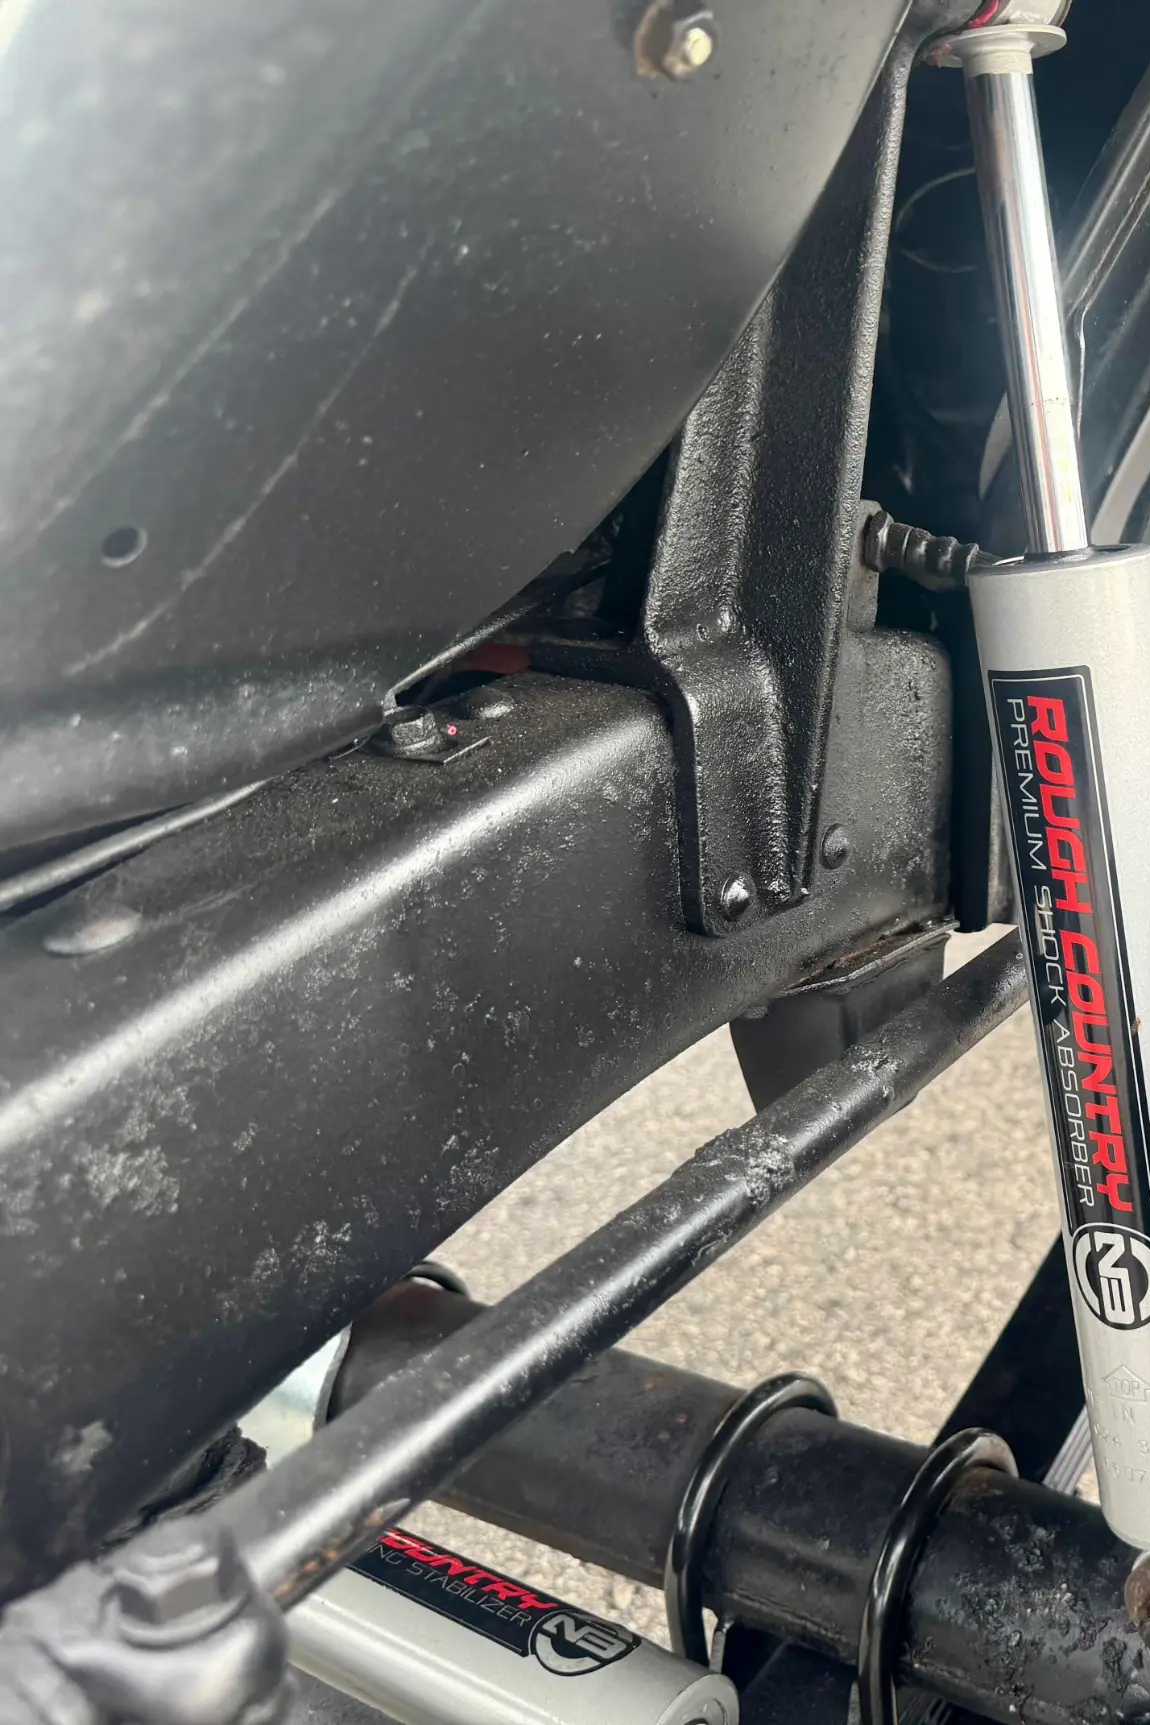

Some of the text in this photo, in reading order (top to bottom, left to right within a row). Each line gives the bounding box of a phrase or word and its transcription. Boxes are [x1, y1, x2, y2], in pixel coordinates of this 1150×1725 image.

[1007, 698, 1095, 1207] PREMIUM SHOCK ABSORBER
[1027, 695, 1133, 1212] ROUGH COUNTRY
[1111, 1376, 1140, 1397] TOP
[378, 1527, 560, 1610] OUNTRY
[405, 1561, 532, 1627] STABILIZER
